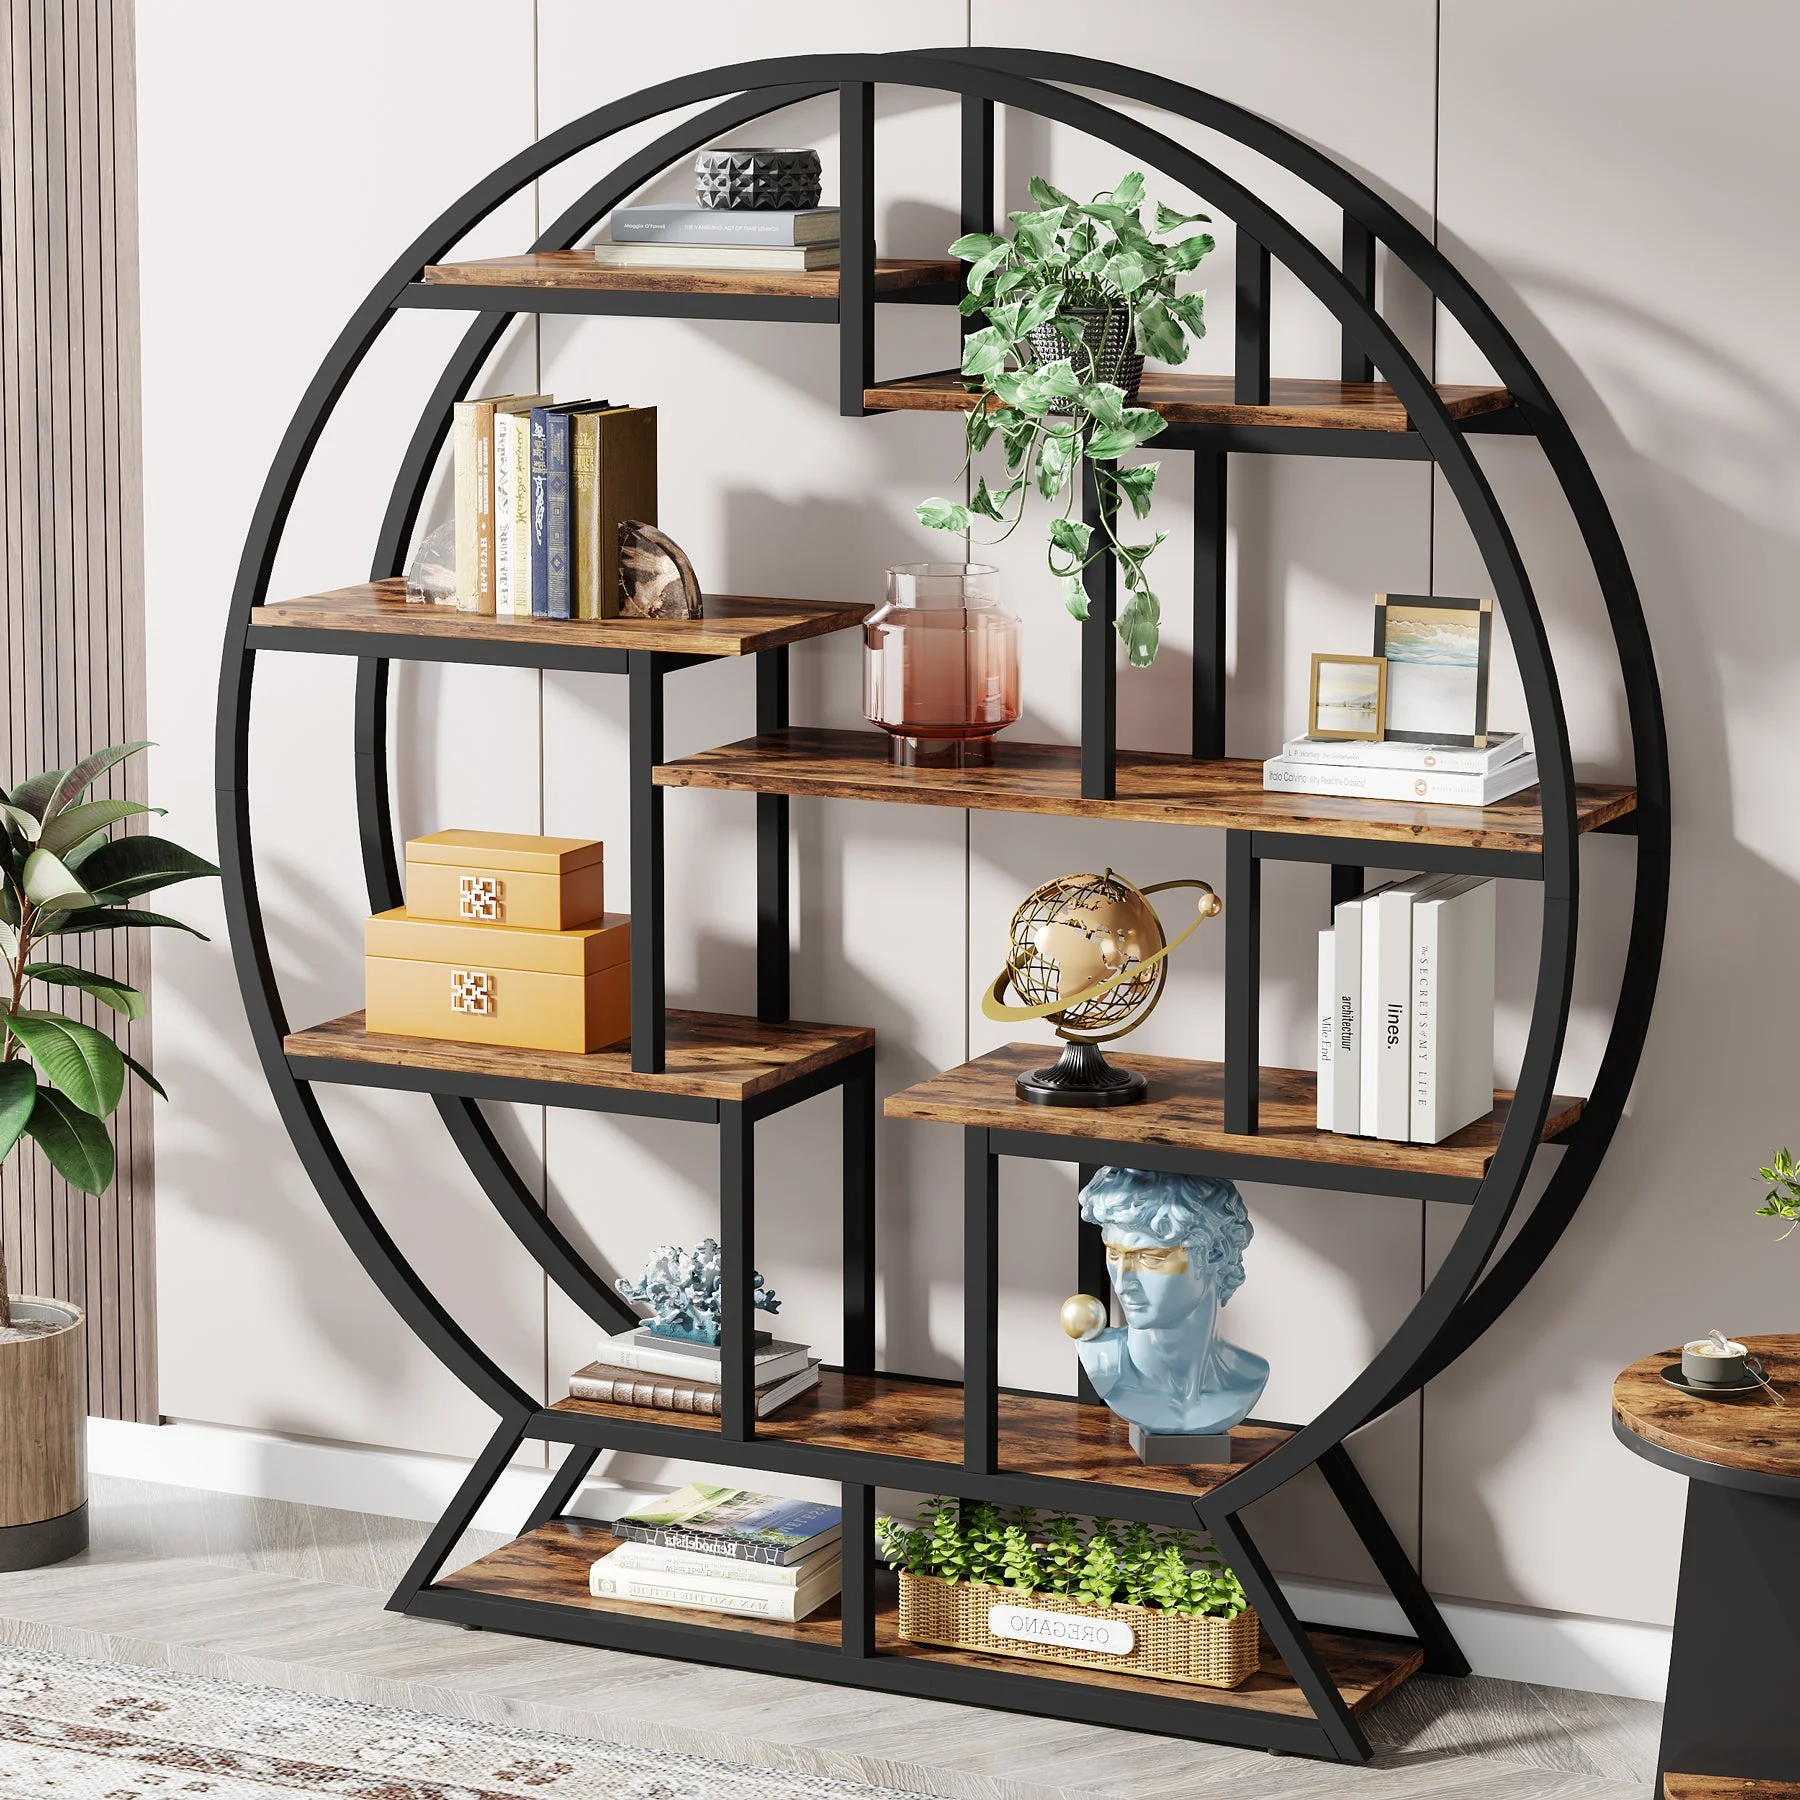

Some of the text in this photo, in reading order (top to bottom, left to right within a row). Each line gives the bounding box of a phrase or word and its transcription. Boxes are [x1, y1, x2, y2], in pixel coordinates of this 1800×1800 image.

[1269, 771, 1283, 781] Italo
[1284, 771, 1307, 784] Calvino
[1418, 957, 1429, 1028] SECRETS
[1321, 1016, 1332, 1062] Mile End
[1341, 995, 1354, 1052] architectuur
[1387, 1003, 1403, 1050] lines.
[1418, 1040, 1428, 1061] MY
[1417, 1071, 1428, 1107] LIFE
